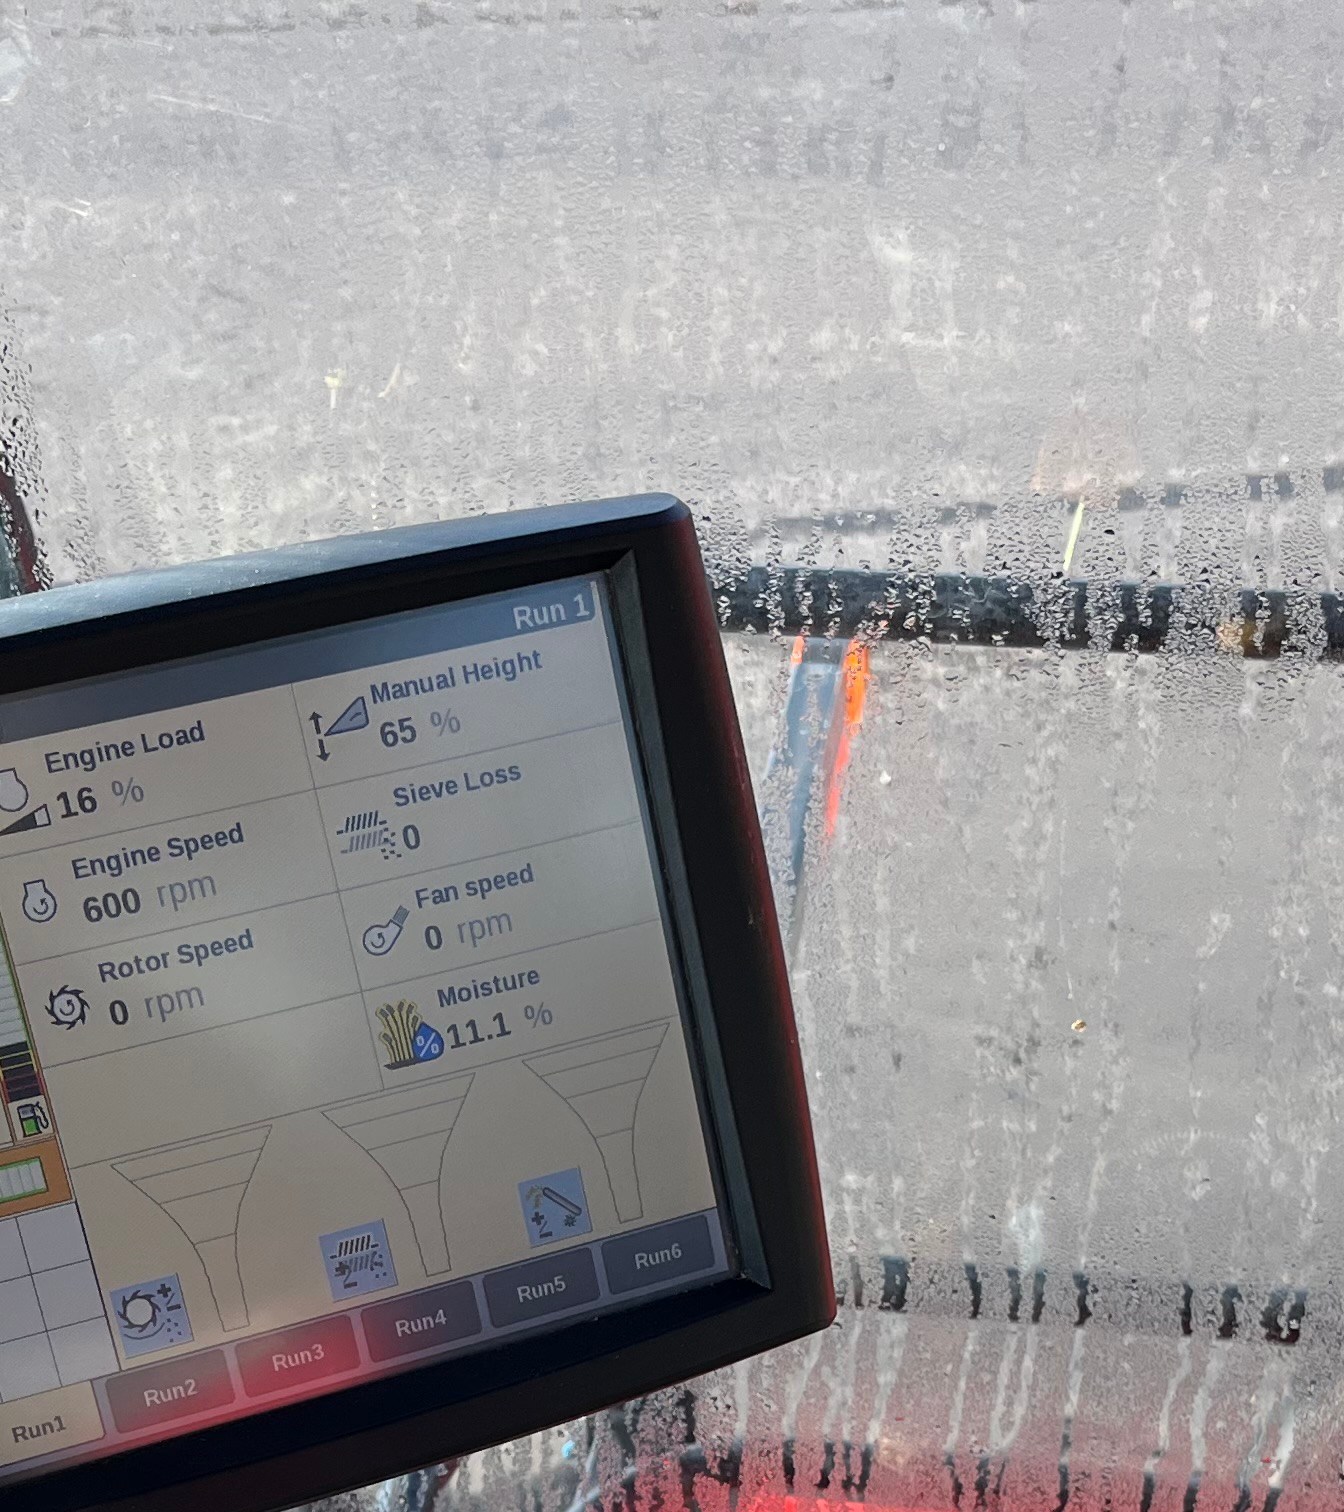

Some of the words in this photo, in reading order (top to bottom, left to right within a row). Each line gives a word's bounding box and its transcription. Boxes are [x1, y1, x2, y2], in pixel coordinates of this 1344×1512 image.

[513, 598, 567, 631] Run
[573, 593, 590, 619] 1
[369, 667, 457, 705] Manual
[462, 648, 544, 687] Height
[44, 736, 136, 775] Engine
[140, 720, 206, 755] Load
[379, 716, 418, 748] 65
[430, 707, 462, 736] %
[58, 786, 99, 820] 16
[111, 776, 145, 806] %
[392, 776, 459, 808] Sieve
[463, 761, 523, 794] Loss
[72, 840, 161, 881] Engine
[166, 822, 245, 863] Speed
[402, 822, 422, 851] 0
[82, 887, 142, 924] 600
[155, 870, 218, 910] rpm
[415, 883, 458, 910] Fan
[464, 863, 536, 903] speed
[424, 925, 444, 951] 0
[457, 910, 514, 948] rpm
[98, 949, 171, 984] Rotor
[177, 929, 255, 969] Speed
[109, 999, 130, 1026] 0
[143, 982, 206, 1022] rpm
[436, 966, 541, 1009] Moisture
[446, 1011, 513, 1051] 11.1
[523, 1001, 554, 1029] %
[633, 1243, 684, 1270] Run6
[516, 1274, 568, 1303] Run5
[394, 1308, 448, 1338] Run4
[271, 1343, 326, 1373] Run3
[143, 1378, 200, 1408] Run2
[11, 1414, 68, 1445] Run1
